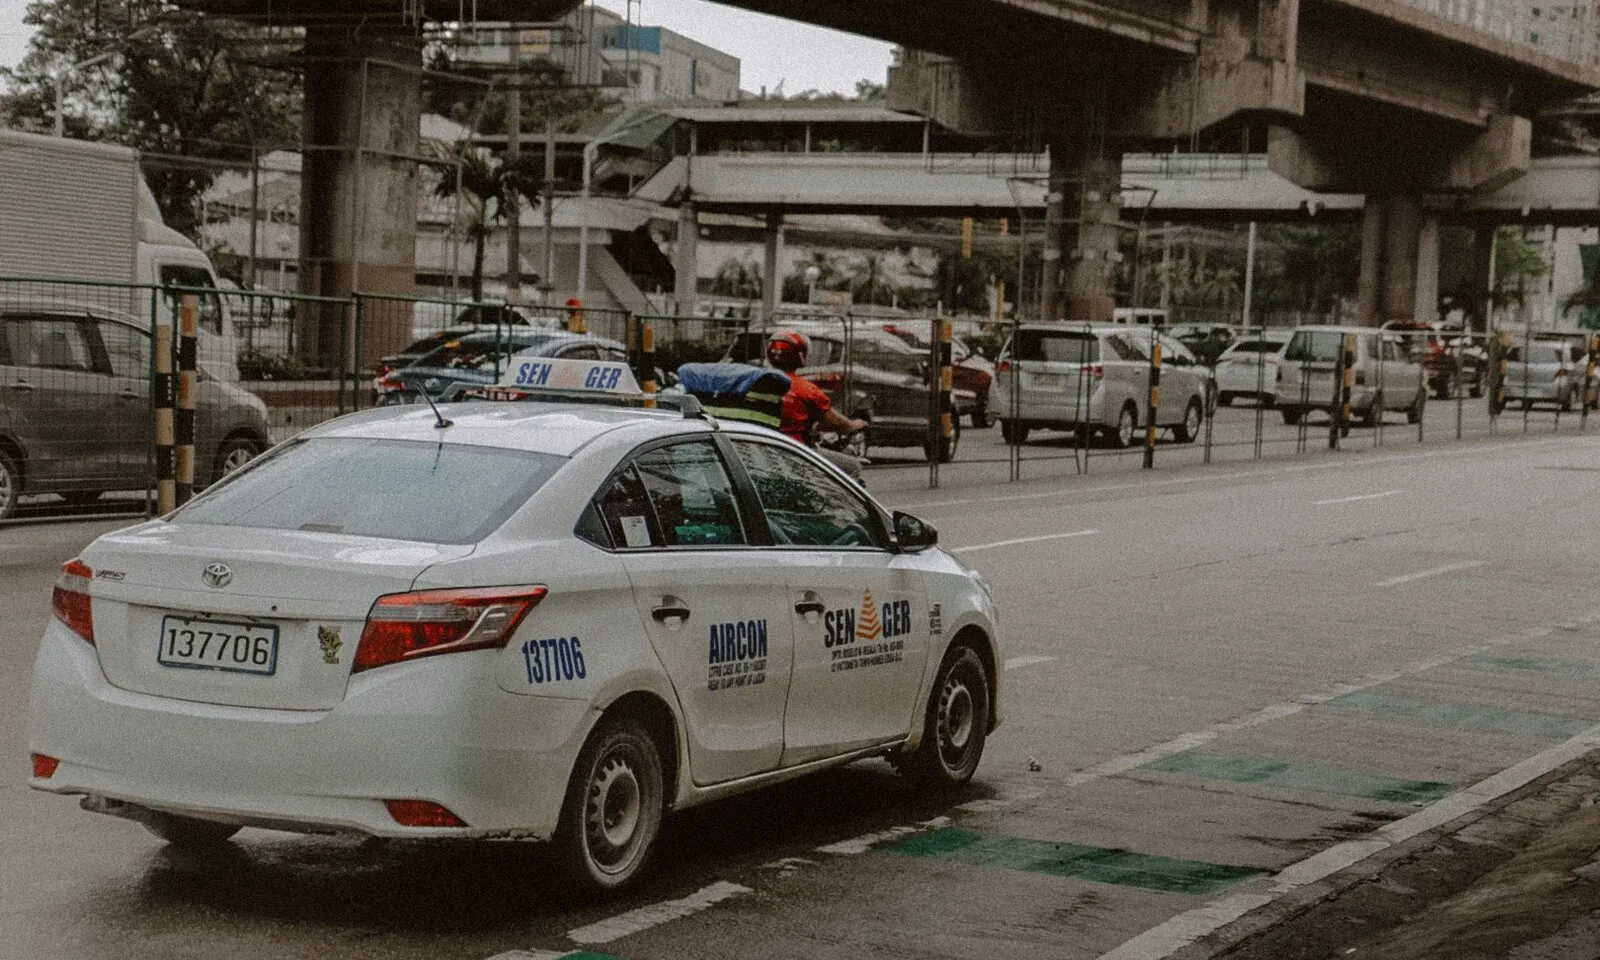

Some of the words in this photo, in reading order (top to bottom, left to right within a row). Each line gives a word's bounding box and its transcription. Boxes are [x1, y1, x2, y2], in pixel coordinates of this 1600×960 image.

[515, 362, 552, 386] SEN
[584, 366, 622, 390] GER
[709, 620, 768, 664] AIRCON
[824, 608, 855, 648] SEN
[882, 600, 911, 639] GER
[167, 628, 270, 665] 137706
[521, 636, 587, 684] 137706
